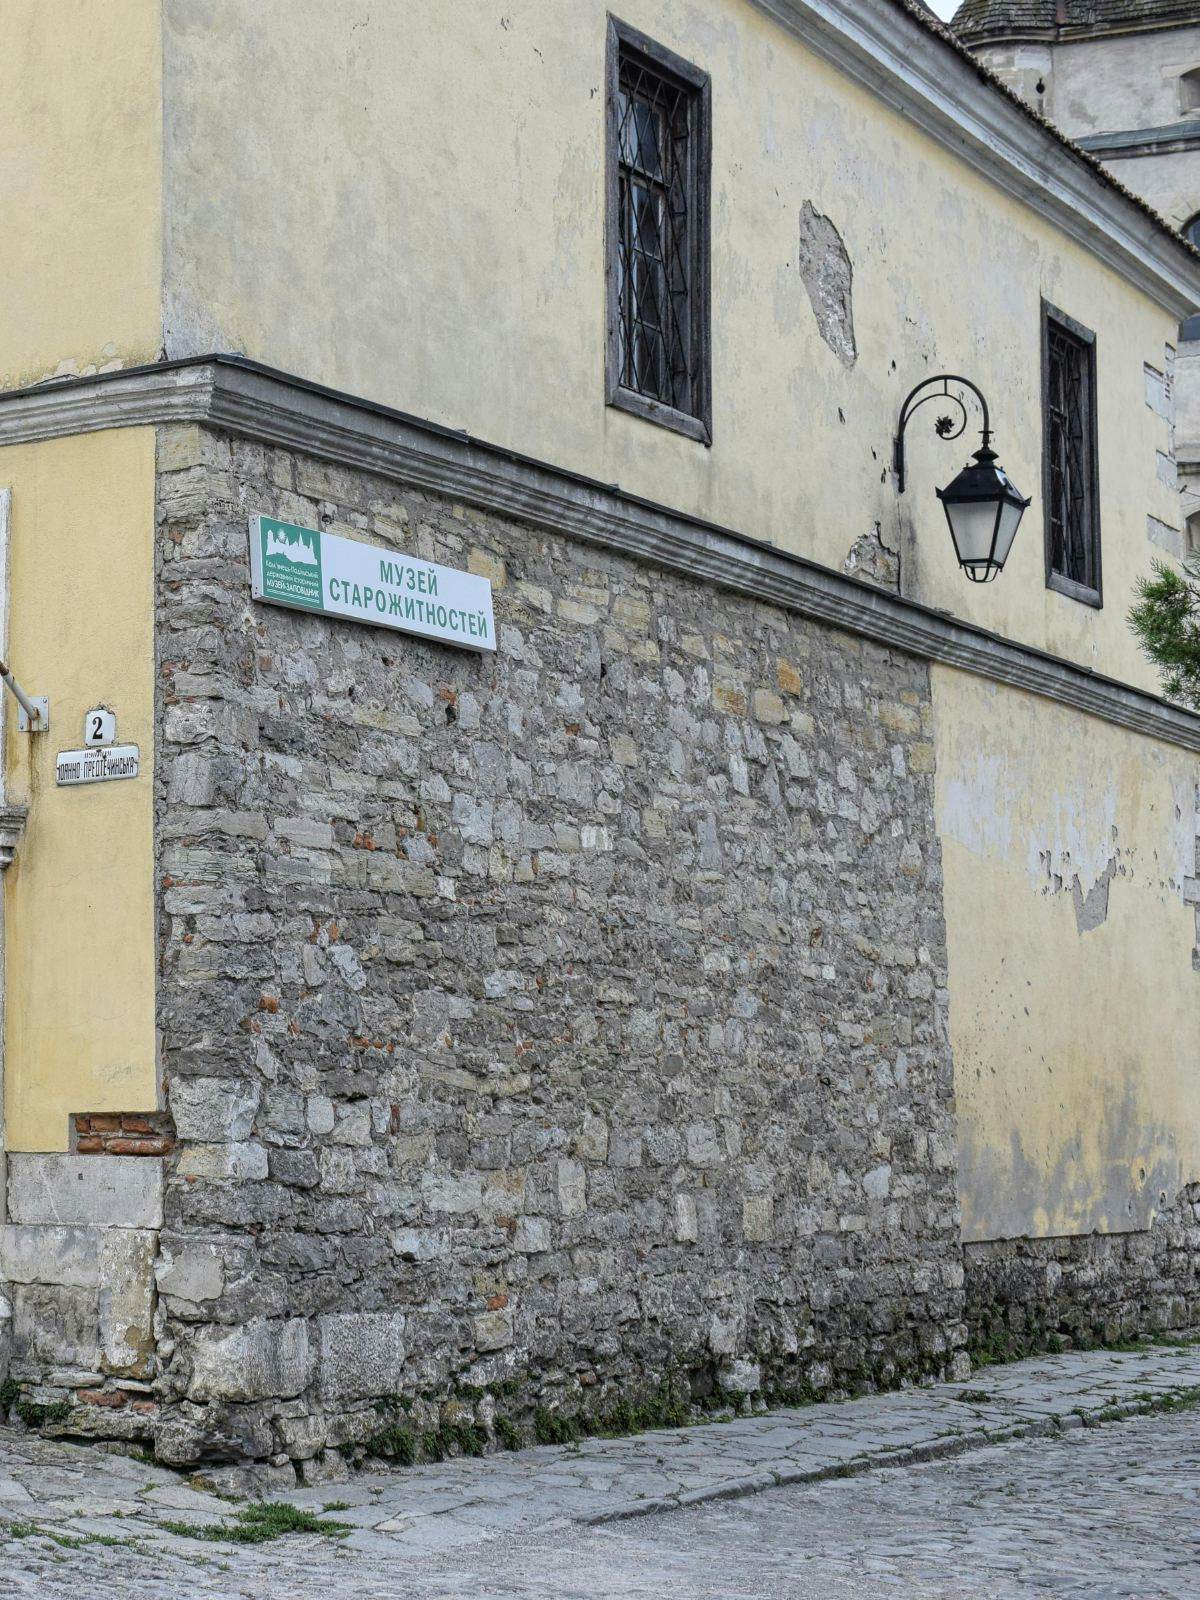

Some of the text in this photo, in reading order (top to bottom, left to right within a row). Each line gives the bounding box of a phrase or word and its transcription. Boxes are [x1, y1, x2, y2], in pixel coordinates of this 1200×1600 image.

[379, 560, 438, 597] МУЗЕЙ
[329, 578, 488, 639] СТАРОЖИТНОСТЕЙ
[92, 716, 103, 740] 2
